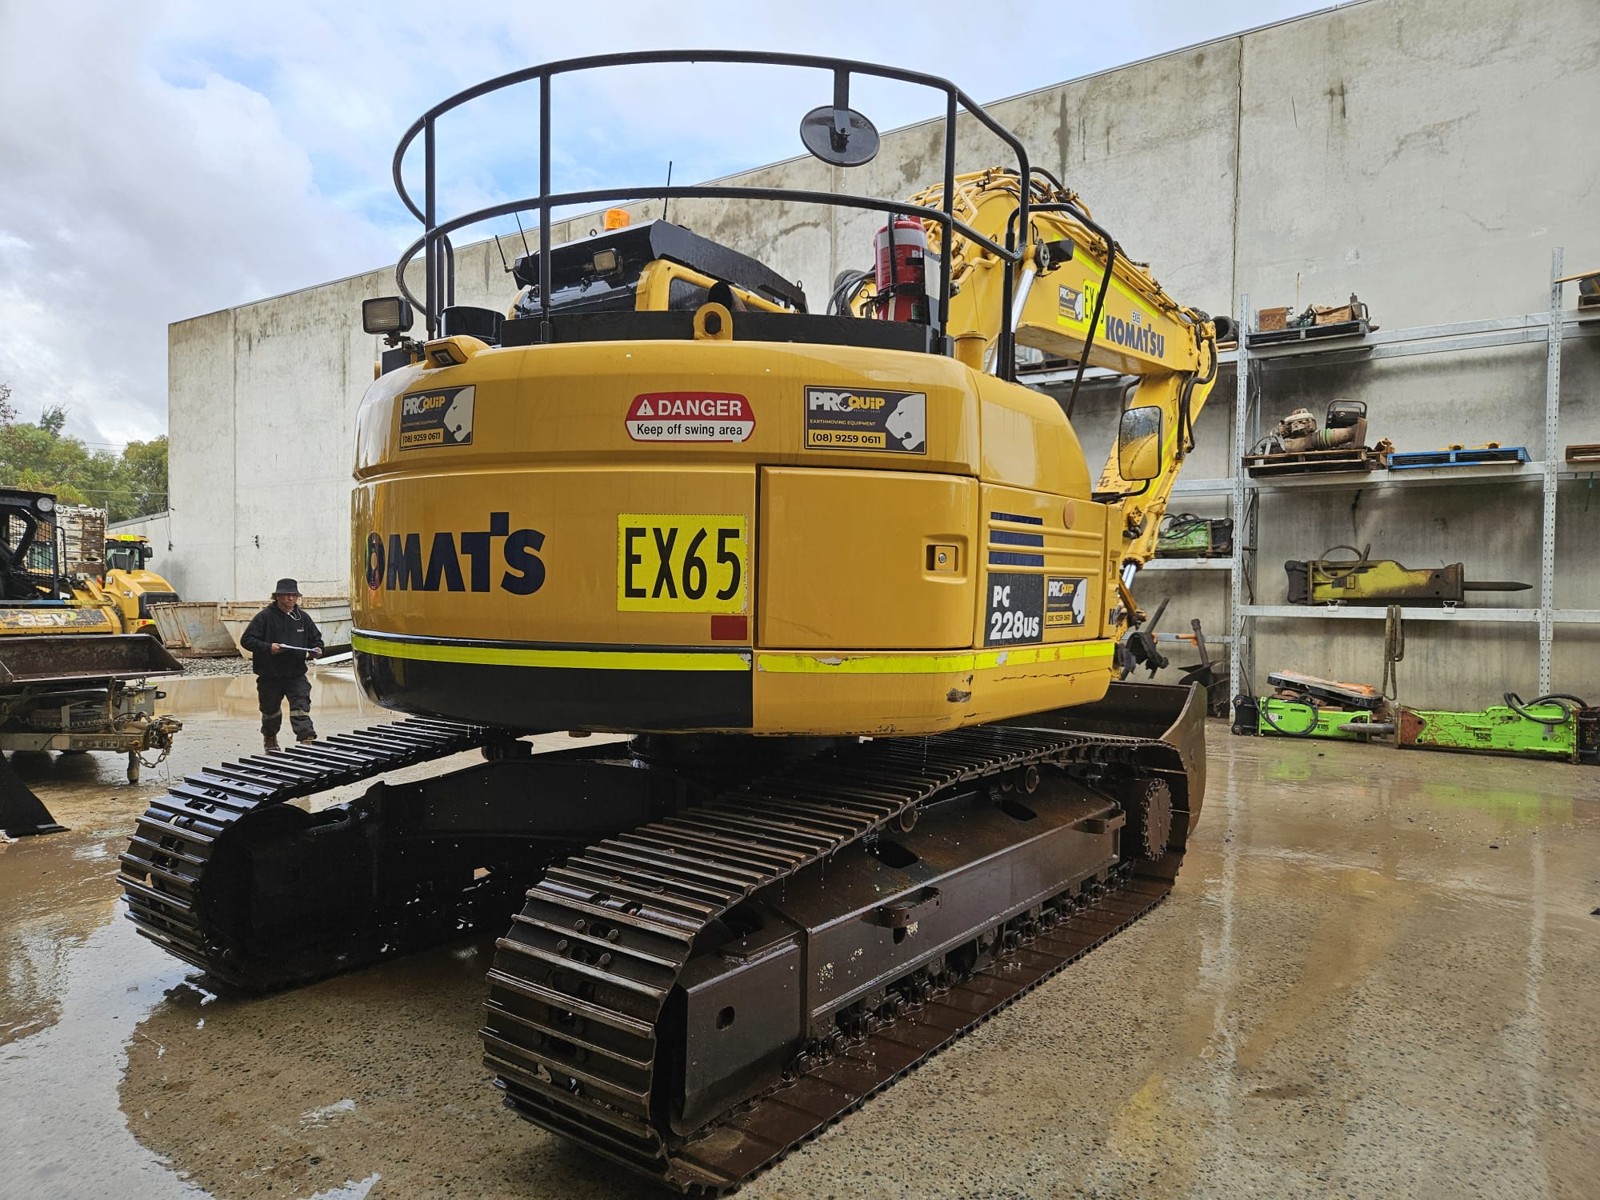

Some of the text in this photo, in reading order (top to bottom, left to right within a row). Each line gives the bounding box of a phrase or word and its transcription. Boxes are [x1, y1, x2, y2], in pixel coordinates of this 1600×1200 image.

[1105, 315, 1165, 359] KOMATSU
[657, 399, 742, 417] DANGER
[413, 433, 427, 442] 9259
[636, 423, 743, 437] Keep off swing area
[812, 432, 881, 444] (08) 9259 0611
[624, 527, 741, 600] EX65
[992, 585, 1011, 608] PC
[989, 610, 1040, 640] 228US
